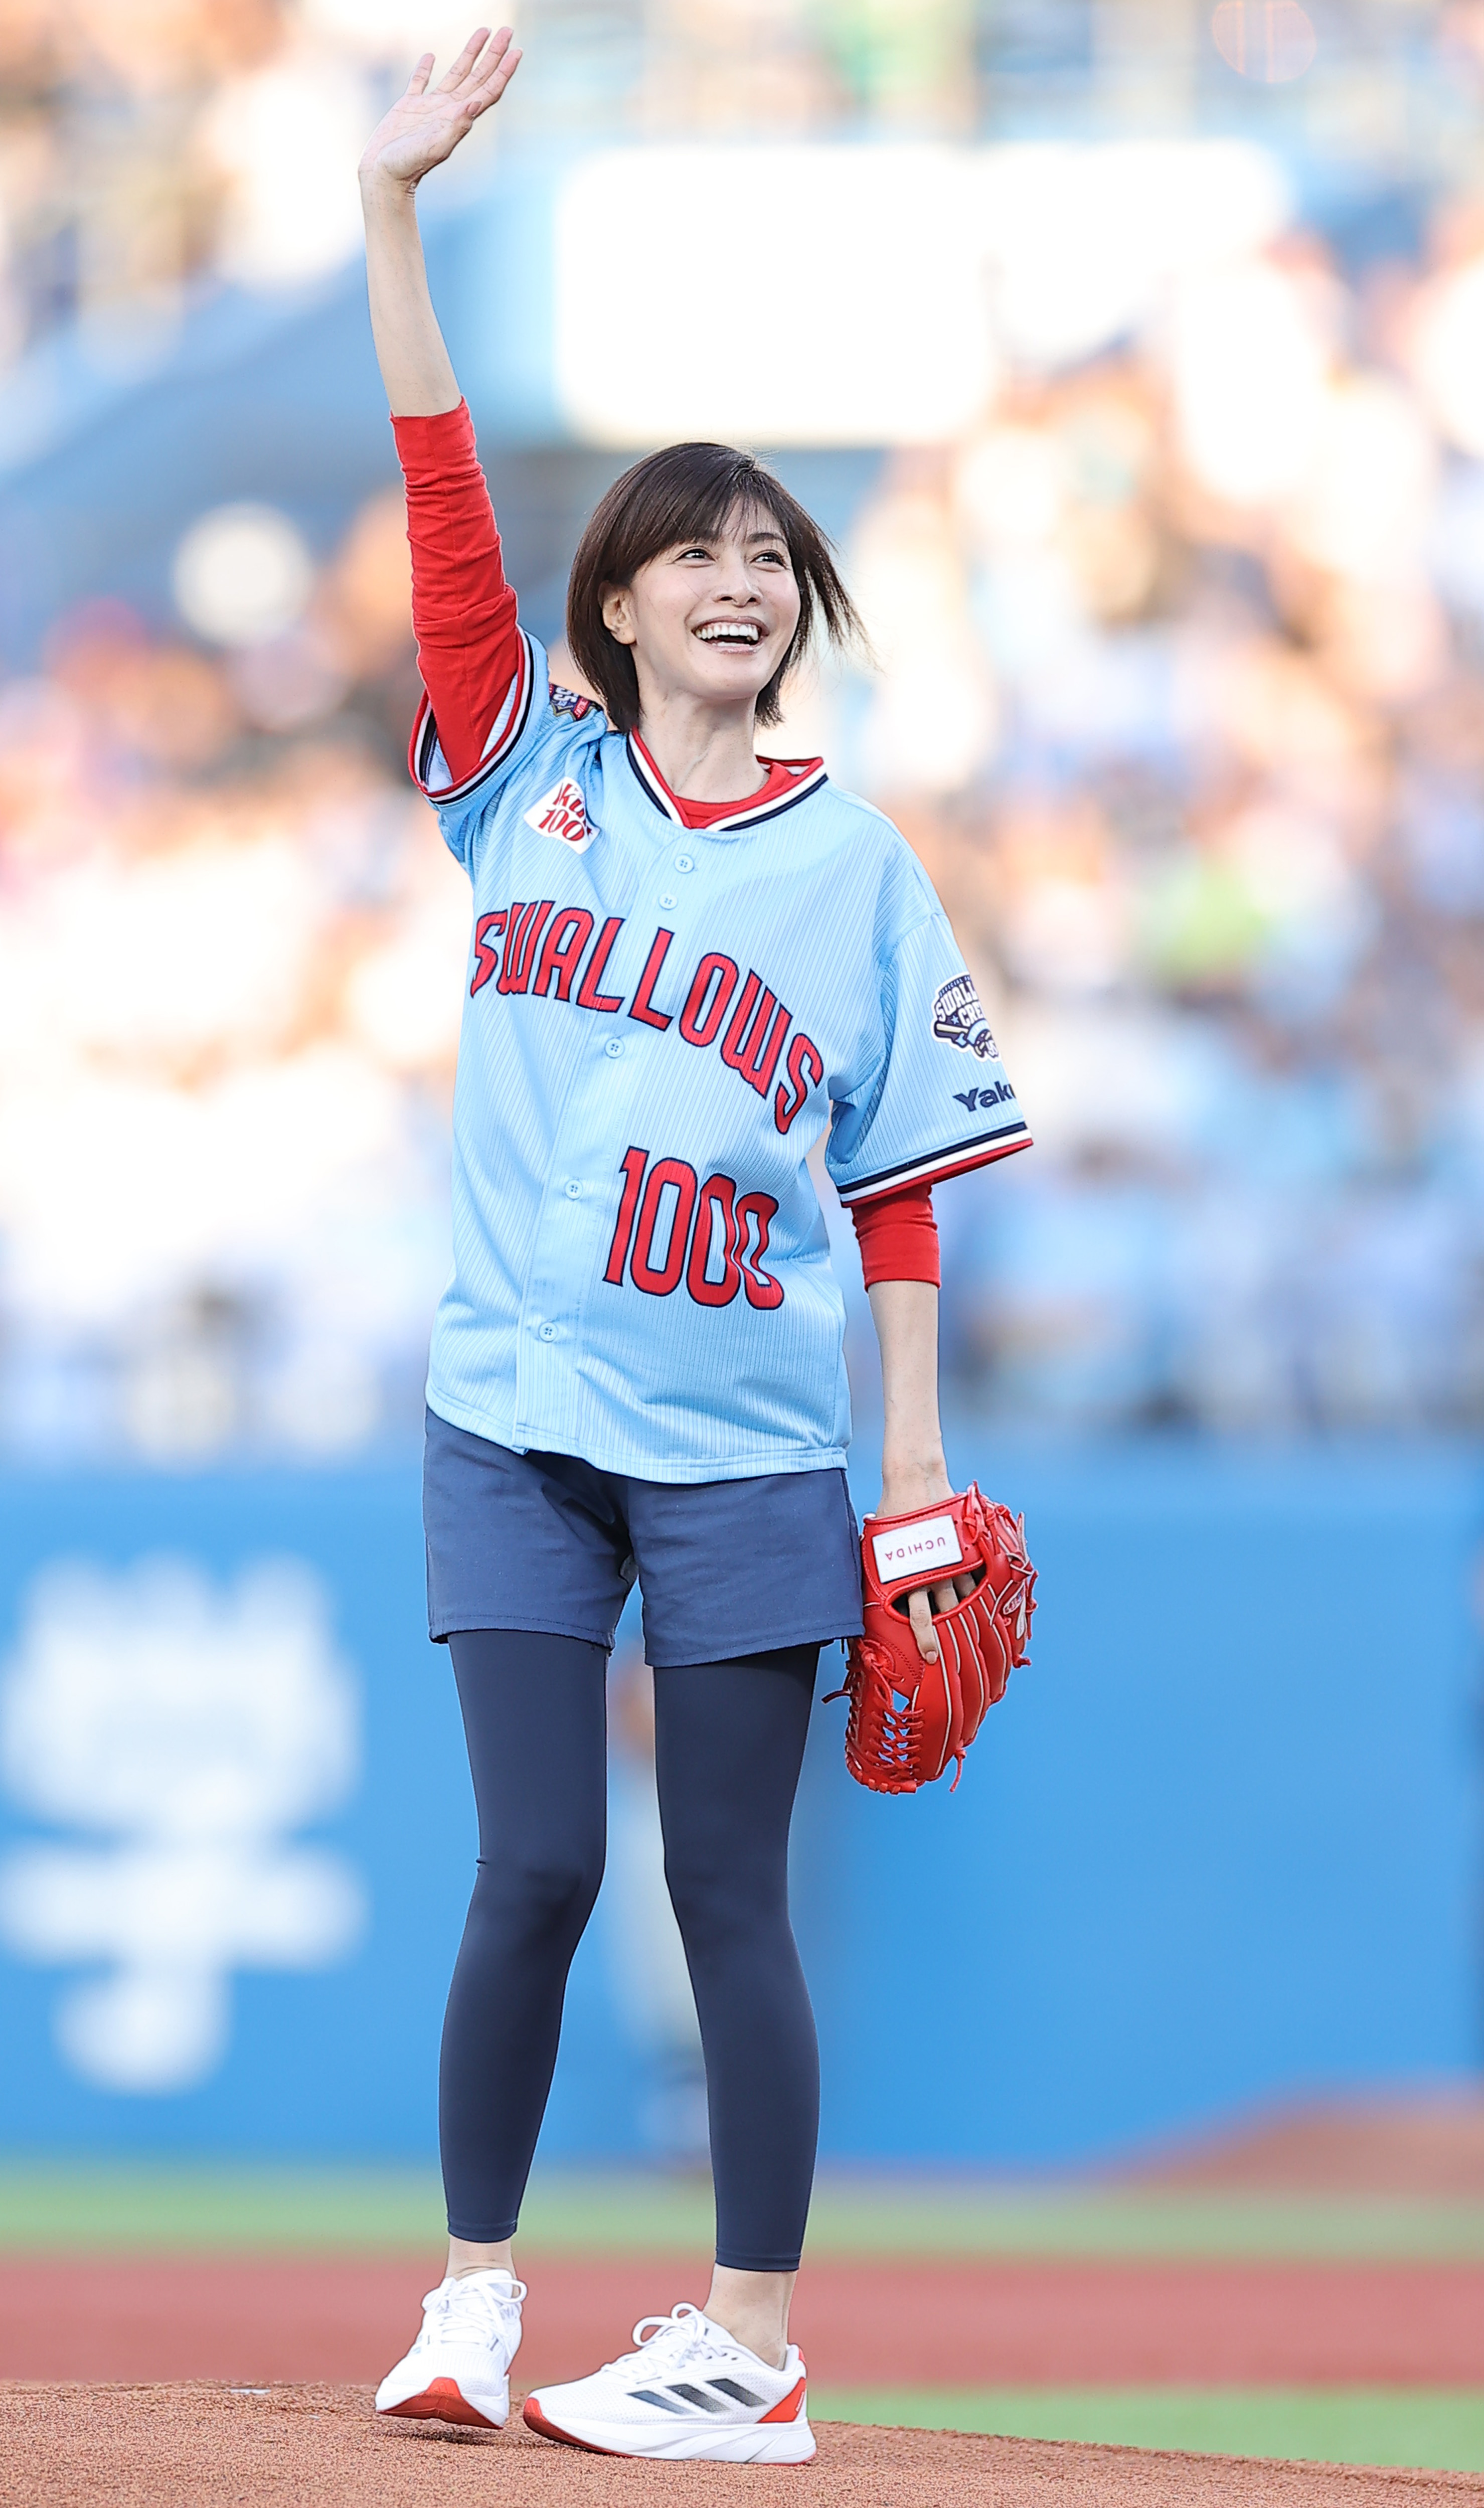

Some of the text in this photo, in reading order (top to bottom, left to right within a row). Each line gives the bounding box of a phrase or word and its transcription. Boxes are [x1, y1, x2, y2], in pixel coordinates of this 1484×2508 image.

[470, 900, 824, 1135] SWALLOWS
[602, 1145, 784, 1310] 1000
[885, 1537, 946, 1561] UCHIDA
